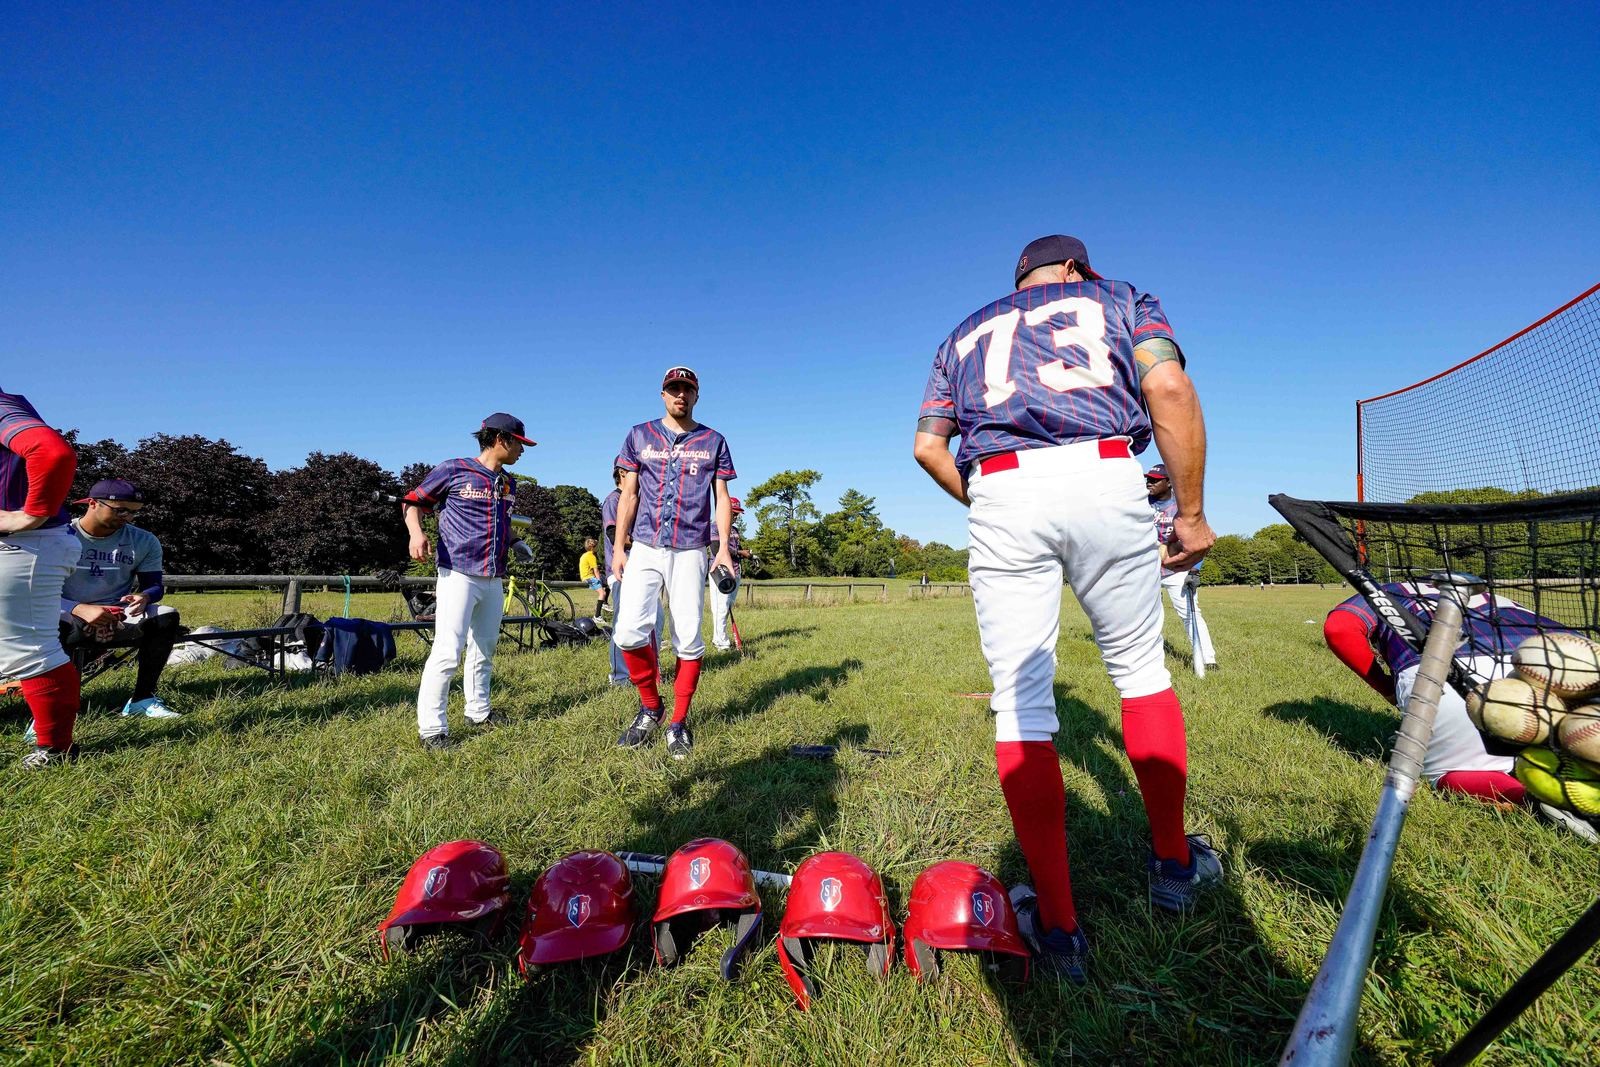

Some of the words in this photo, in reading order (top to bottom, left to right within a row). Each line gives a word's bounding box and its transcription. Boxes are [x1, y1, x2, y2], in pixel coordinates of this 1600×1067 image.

[955, 296, 1115, 409] 73
[641, 444, 669, 459] Stade
[689, 463, 698, 475] 6
[459, 483, 492, 499] Stade
[90, 562, 104, 576] LA
[572, 901, 587, 915] SF
[977, 899, 990, 912] SF
